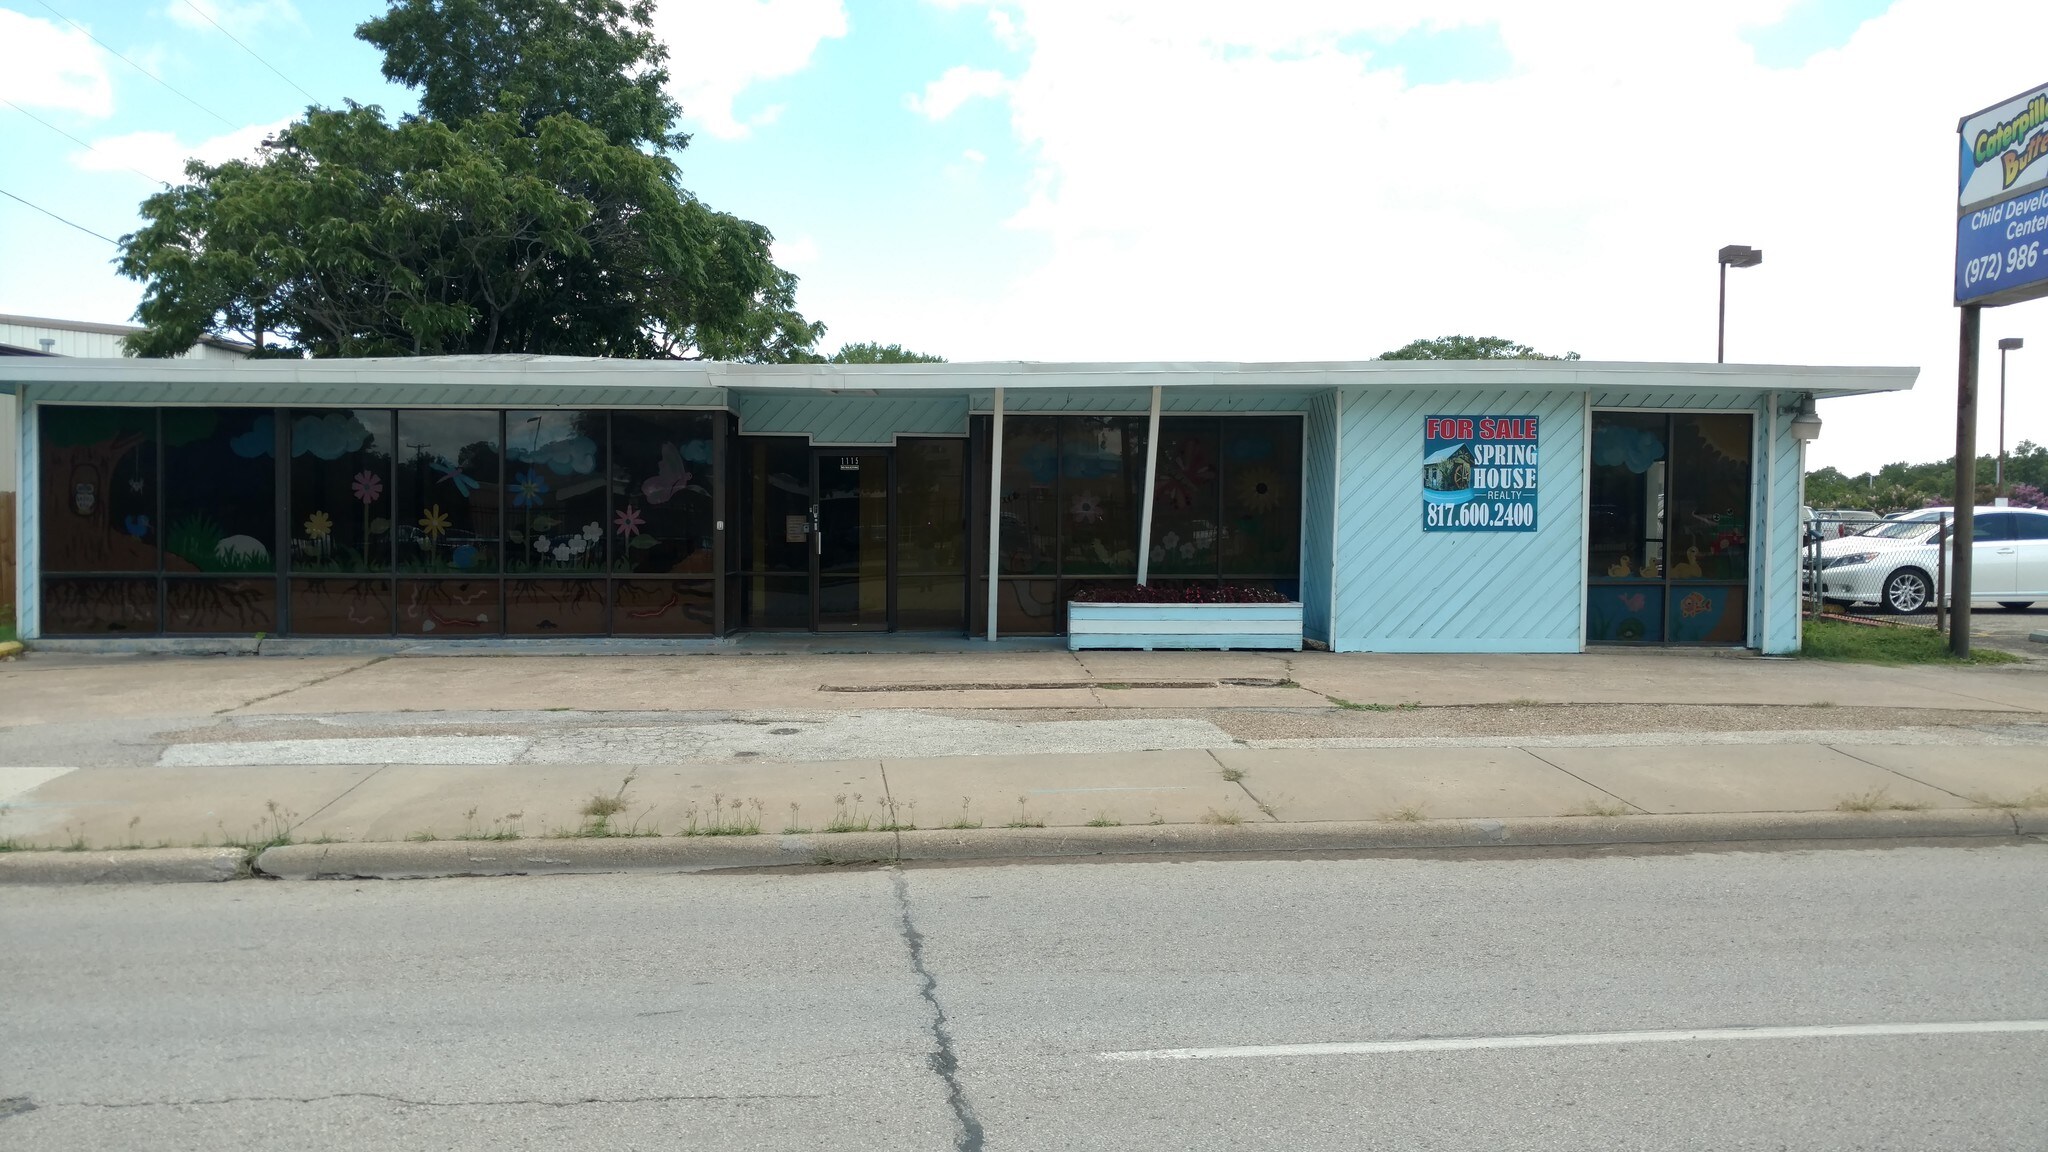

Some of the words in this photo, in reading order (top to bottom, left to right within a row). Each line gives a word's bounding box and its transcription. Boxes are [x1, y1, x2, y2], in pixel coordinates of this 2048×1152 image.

[1971, 204, 2004, 230] Child
[1965, 252, 2002, 288] (972)
[2006, 241, 2040, 273] 986
[1427, 418, 1473, 439] FOR
[1479, 418, 1537, 440] SALE
[841, 457, 858, 465] 1115
[1474, 444, 1537, 465] SPRING
[1473, 468, 1536, 489] HOUSE
[1487, 491, 1522, 500] REALTY
[1427, 502, 1533, 527] 817.600.2400
